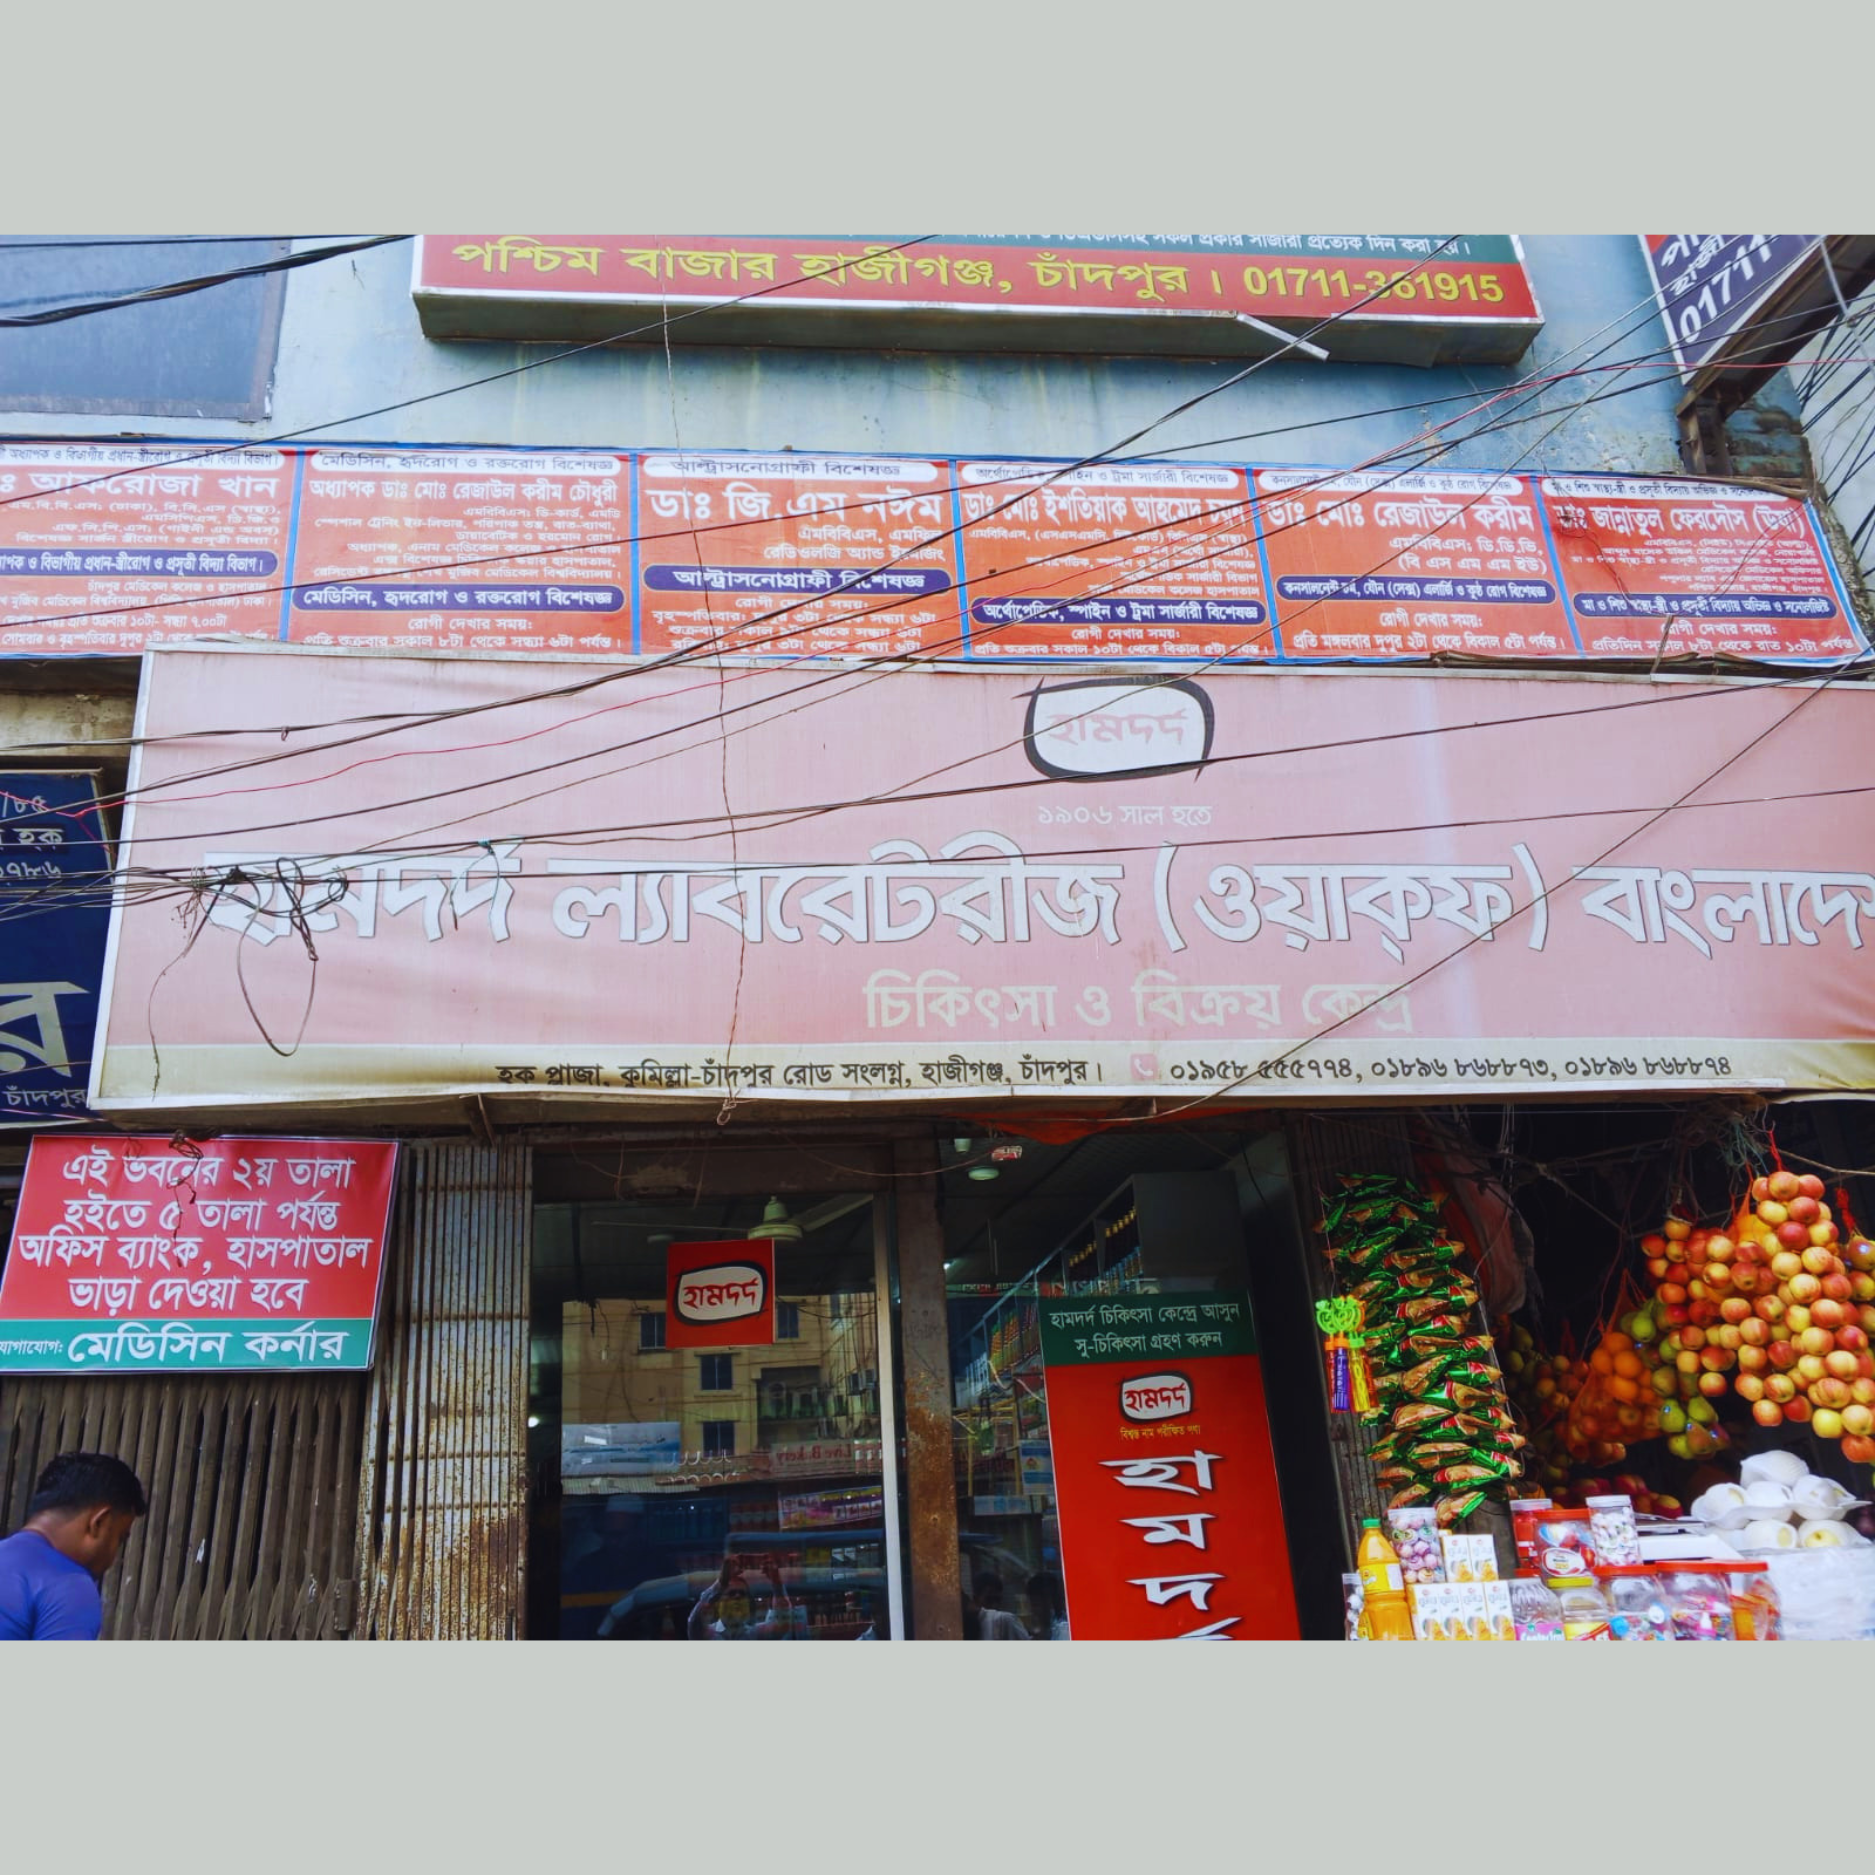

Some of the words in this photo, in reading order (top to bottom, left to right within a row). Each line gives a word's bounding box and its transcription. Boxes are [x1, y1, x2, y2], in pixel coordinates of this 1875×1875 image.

[452, 235, 605, 277] পশ্চিম
[619, 246, 778, 282] বাজার
[792, 245, 1012, 294] হাজীগঞ্জ,
[1026, 251, 1190, 302] চাঁদপুর
[1243, 265, 1506, 303] 01711-361915
[218, 475, 281, 499] খান
[309, 479, 376, 500] অধ্যাপক
[381, 480, 409, 501] ডাঃ
[414, 482, 448, 501] মোঃ
[453, 479, 516, 502] রেজাউল
[521, 479, 562, 502] করীম
[568, 478, 619, 508] চৌধুরী
[645, 487, 712, 521] ডাঃ
[1470, 495, 1535, 532] করীম
[302, 586, 378, 609] মেডিসিন,
[383, 588, 448, 608] হৃদরোগ
[453, 590, 469, 605] ও
[474, 588, 540, 608] রক্তরোগ
[546, 587, 613, 607] বিশেষজ্ঞ
[408, 613, 443, 631] রোগী
[449, 617, 491, 631] দেখার
[1379, 607, 1410, 628] রোগী
[1046, 707, 1189, 747] হামদর্দ
[1038, 804, 1113, 825] ১৯০৬
[1117, 805, 1165, 826] সাল
[1169, 805, 1214, 827] হতে
[862, 968, 1057, 1029] চিকিৎসা
[1074, 985, 1112, 1027] ও
[1130, 968, 1281, 1030] বিক্রয়
[495, 1064, 538, 1085] হক
[783, 1062, 836, 1086] রোড
[841, 1061, 912, 1089] সংলগ্ন,
[918, 1054, 1012, 1085] হাজীগঞ্জ,
[1018, 1054, 1089, 1086] চাঁদপুর
[1170, 1059, 1249, 1082] ০১৯৫৮
[1257, 1058, 1363, 1084] ৫৫৫৭৭৪,
[1371, 1057, 1448, 1078] ০১৮৯৬
[1454, 1057, 1557, 1082] ৮৬৮৮৭৩,
[1565, 1056, 1638, 1077] ০১৮৯৬
[1643, 1056, 1732, 1077] ৮৬৮৮৭৪
[62, 1145, 115, 1186] এই
[122, 1156, 224, 1188] ভবনের
[232, 1157, 278, 1191] ২য়
[285, 1157, 357, 1188] তালা
[63, 1190, 153, 1233] হইতে
[195, 1198, 268, 1232] তালা
[276, 1190, 341, 1233] পর্যন্ত
[18, 1225, 110, 1268] অফিস
[116, 1234, 213, 1275] ব্যাংক,
[226, 1236, 374, 1270] হাসপাতাল
[67, 1275, 143, 1317] ভাড়া
[148, 1276, 242, 1311] দেওয়া
[249, 1277, 309, 1312] হবে
[681, 1277, 760, 1310] হামদর্দ
[1049, 1304, 1096, 1330] হামদর্দ
[1099, 1303, 1153, 1326] চিকিৎসা
[1158, 1305, 1198, 1324] কেন্দ্রে
[1201, 1302, 1241, 1323] আসুন
[67, 1321, 232, 1362] মেডিসিন
[241, 1320, 350, 1362] কর্নার
[1073, 1331, 1148, 1359] সু-চিকিৎসা
[1150, 1333, 1182, 1351] গ্রহণ
[1186, 1330, 1223, 1348] করুন
[1123, 1382, 1188, 1412] হামদর্দ
